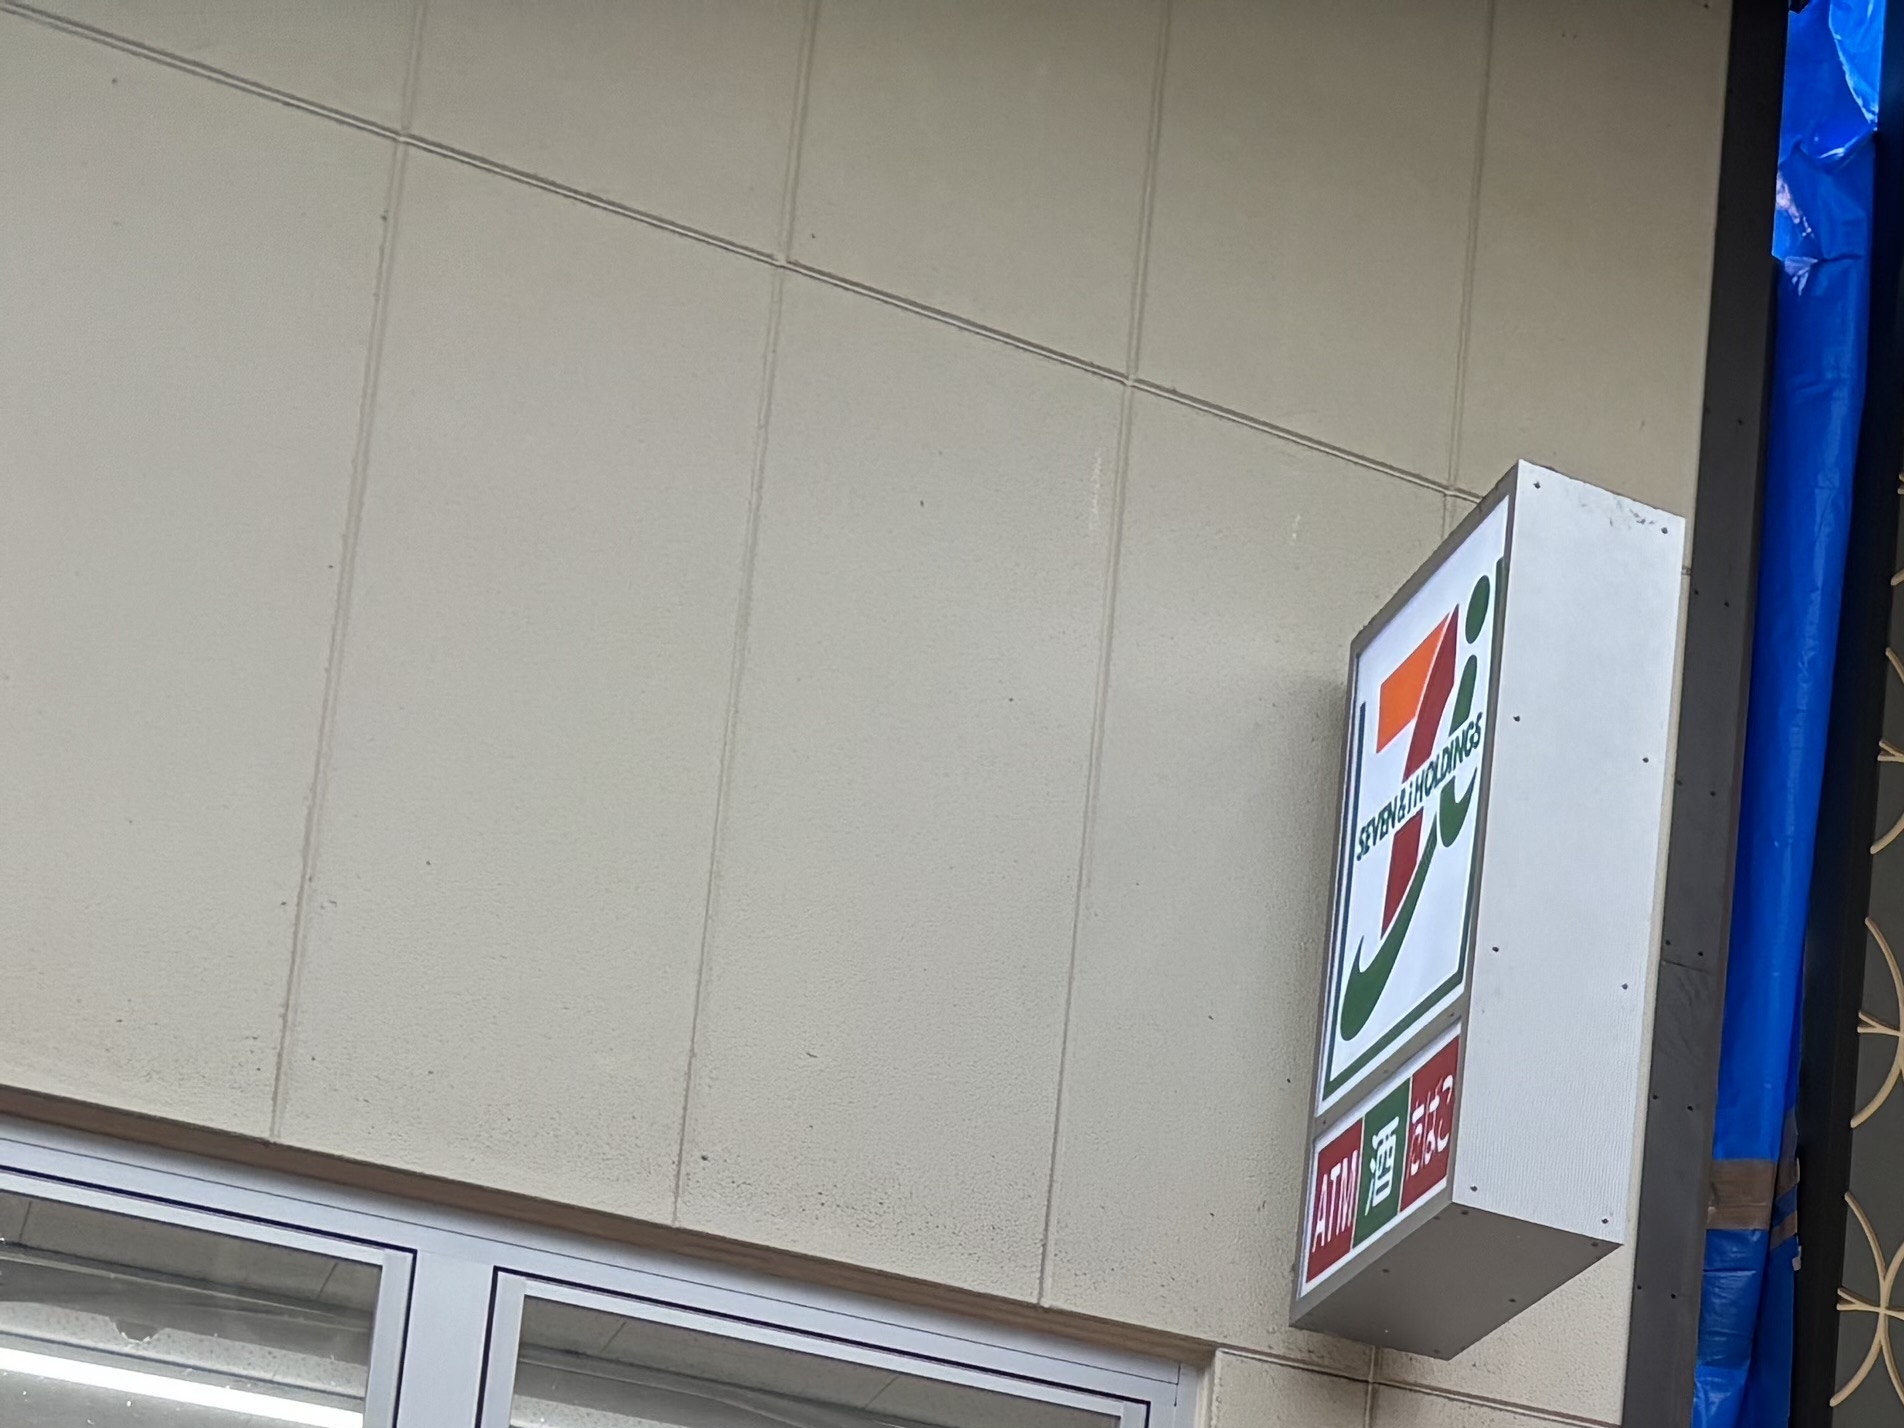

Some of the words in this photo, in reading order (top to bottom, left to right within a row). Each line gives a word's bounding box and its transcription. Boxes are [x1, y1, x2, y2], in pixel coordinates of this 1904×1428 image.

[1357, 796, 1397, 861] SEVEN
[1414, 711, 1483, 808] HOLDINGS
[1364, 1115, 1399, 1216] 酒
[1406, 1074, 1454, 1180] たばこ
[1312, 1149, 1359, 1254] ATM
